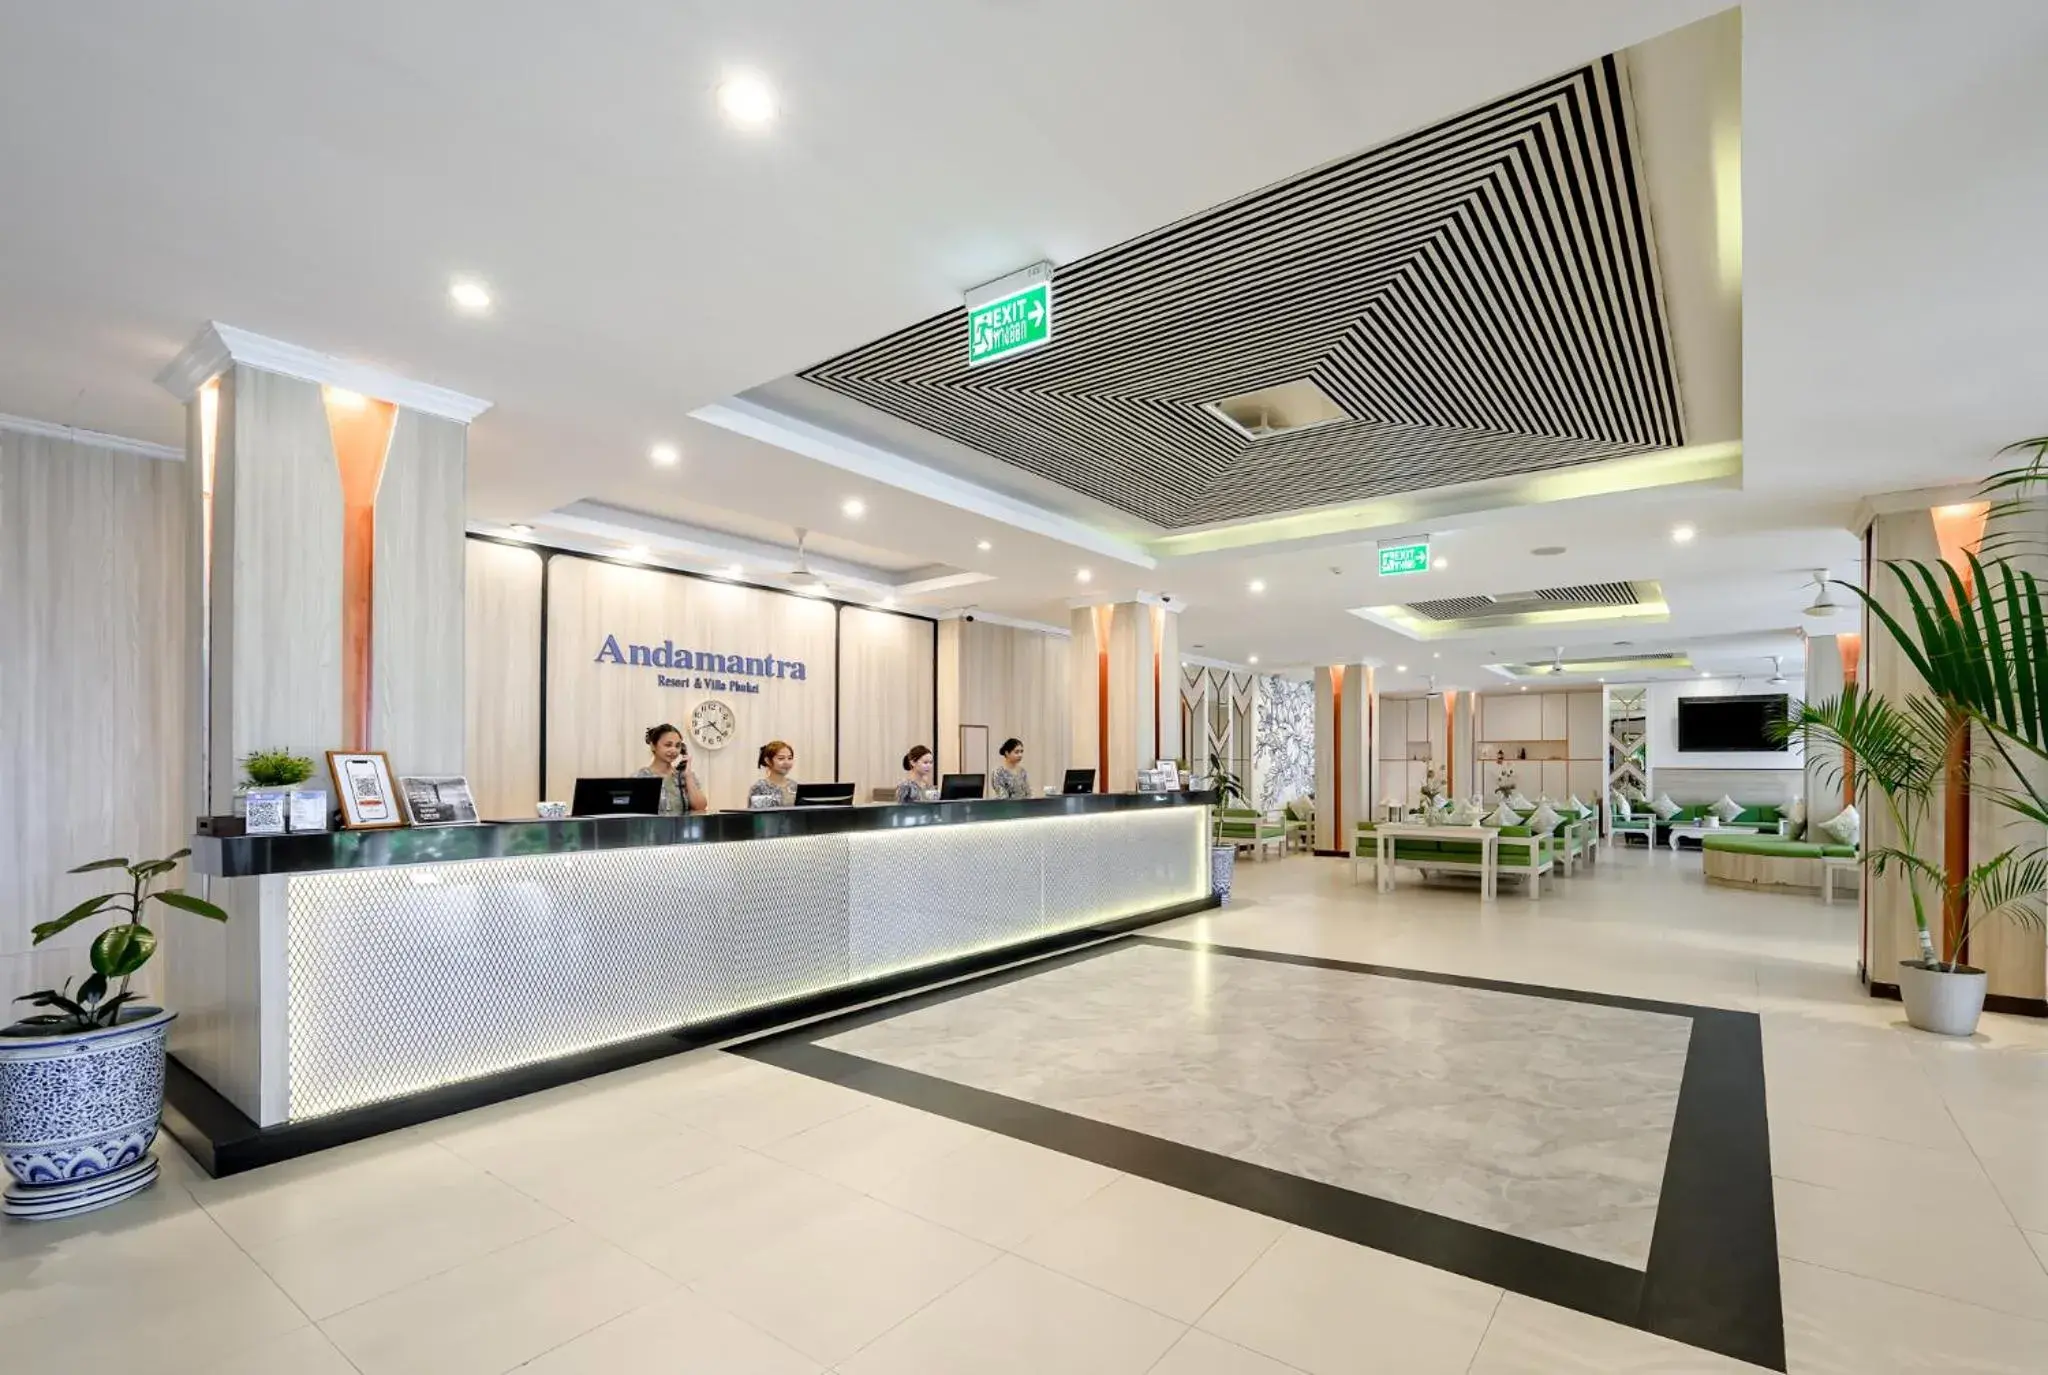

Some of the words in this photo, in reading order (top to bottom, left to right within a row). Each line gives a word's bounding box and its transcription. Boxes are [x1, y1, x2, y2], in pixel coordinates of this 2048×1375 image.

[993, 298, 1027, 329] EXIT
[595, 634, 806, 680] Andamantra
[657, 674, 690, 689] Resort
[693, 676, 703, 689] &
